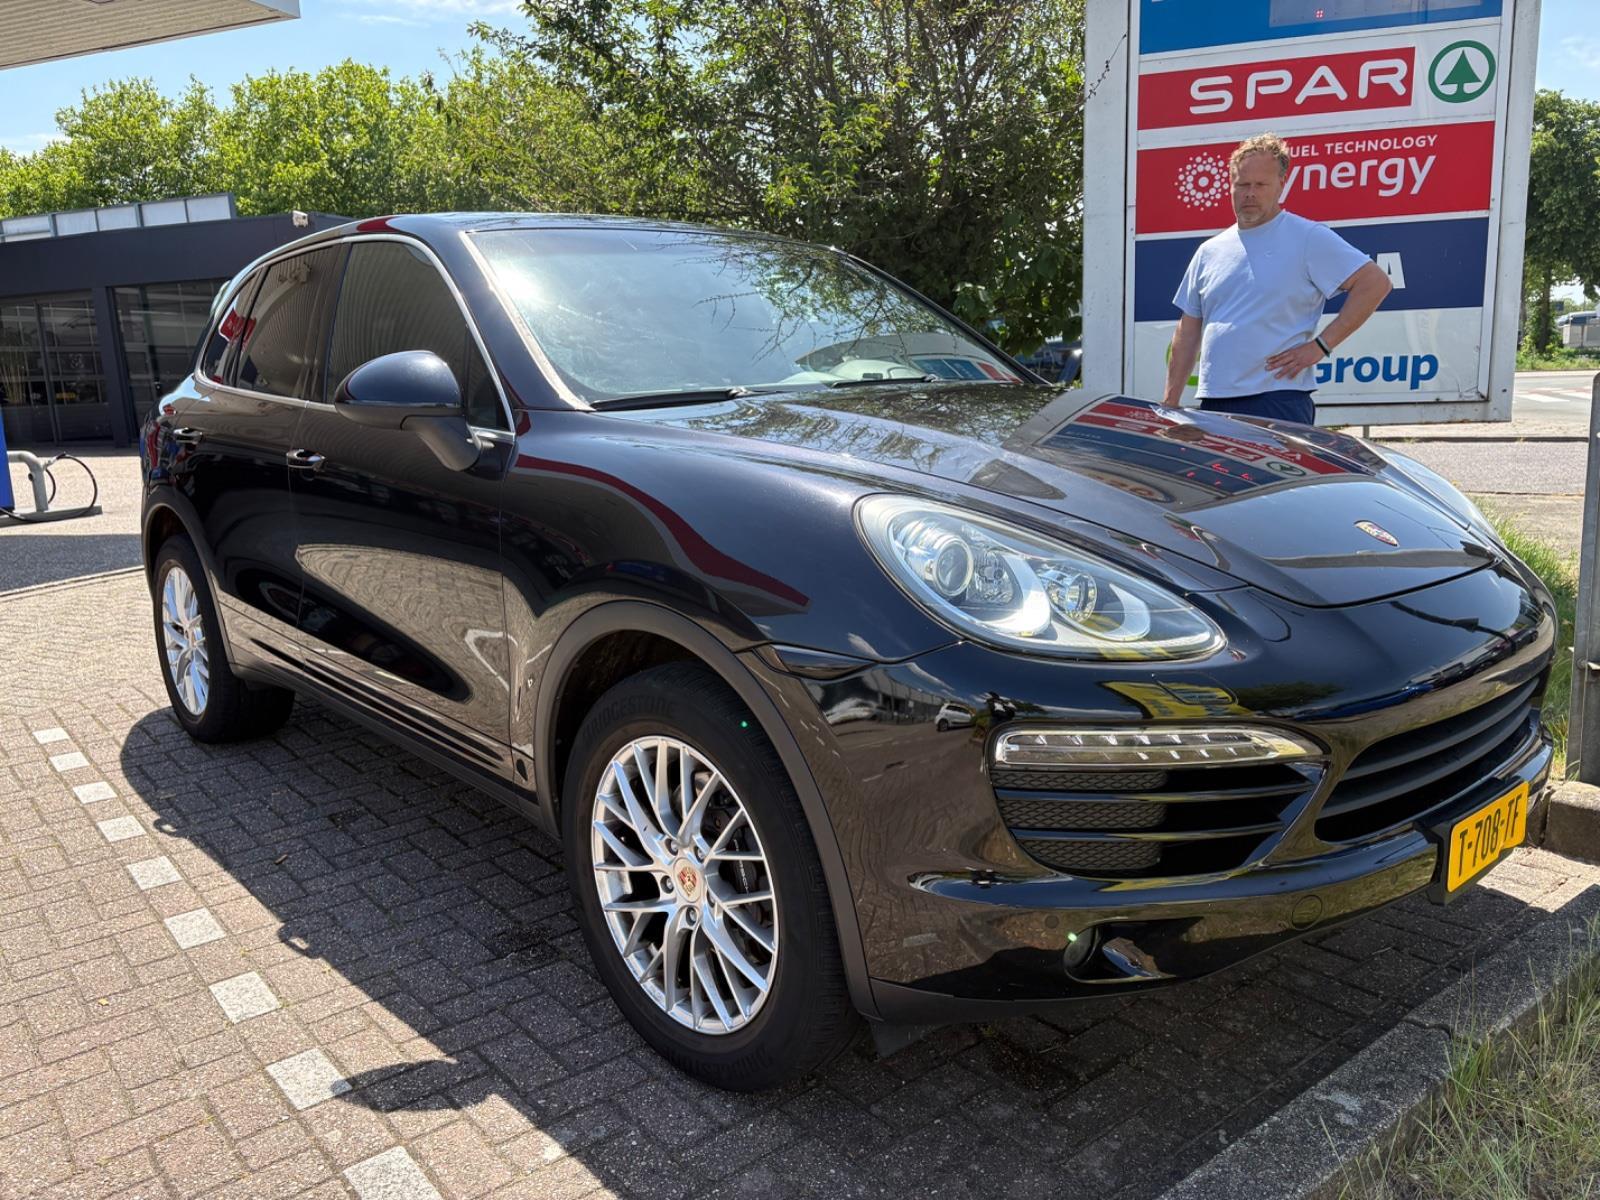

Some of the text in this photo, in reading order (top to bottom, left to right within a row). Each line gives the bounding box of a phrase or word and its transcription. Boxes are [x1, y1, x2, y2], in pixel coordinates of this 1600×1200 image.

[1189, 58, 1408, 115] SPAR
[1288, 134, 1438, 158] UEL TECHNOLOGY
[1277, 155, 1437, 204] ynergy
[1459, 794, 1522, 878] T-708-TF
